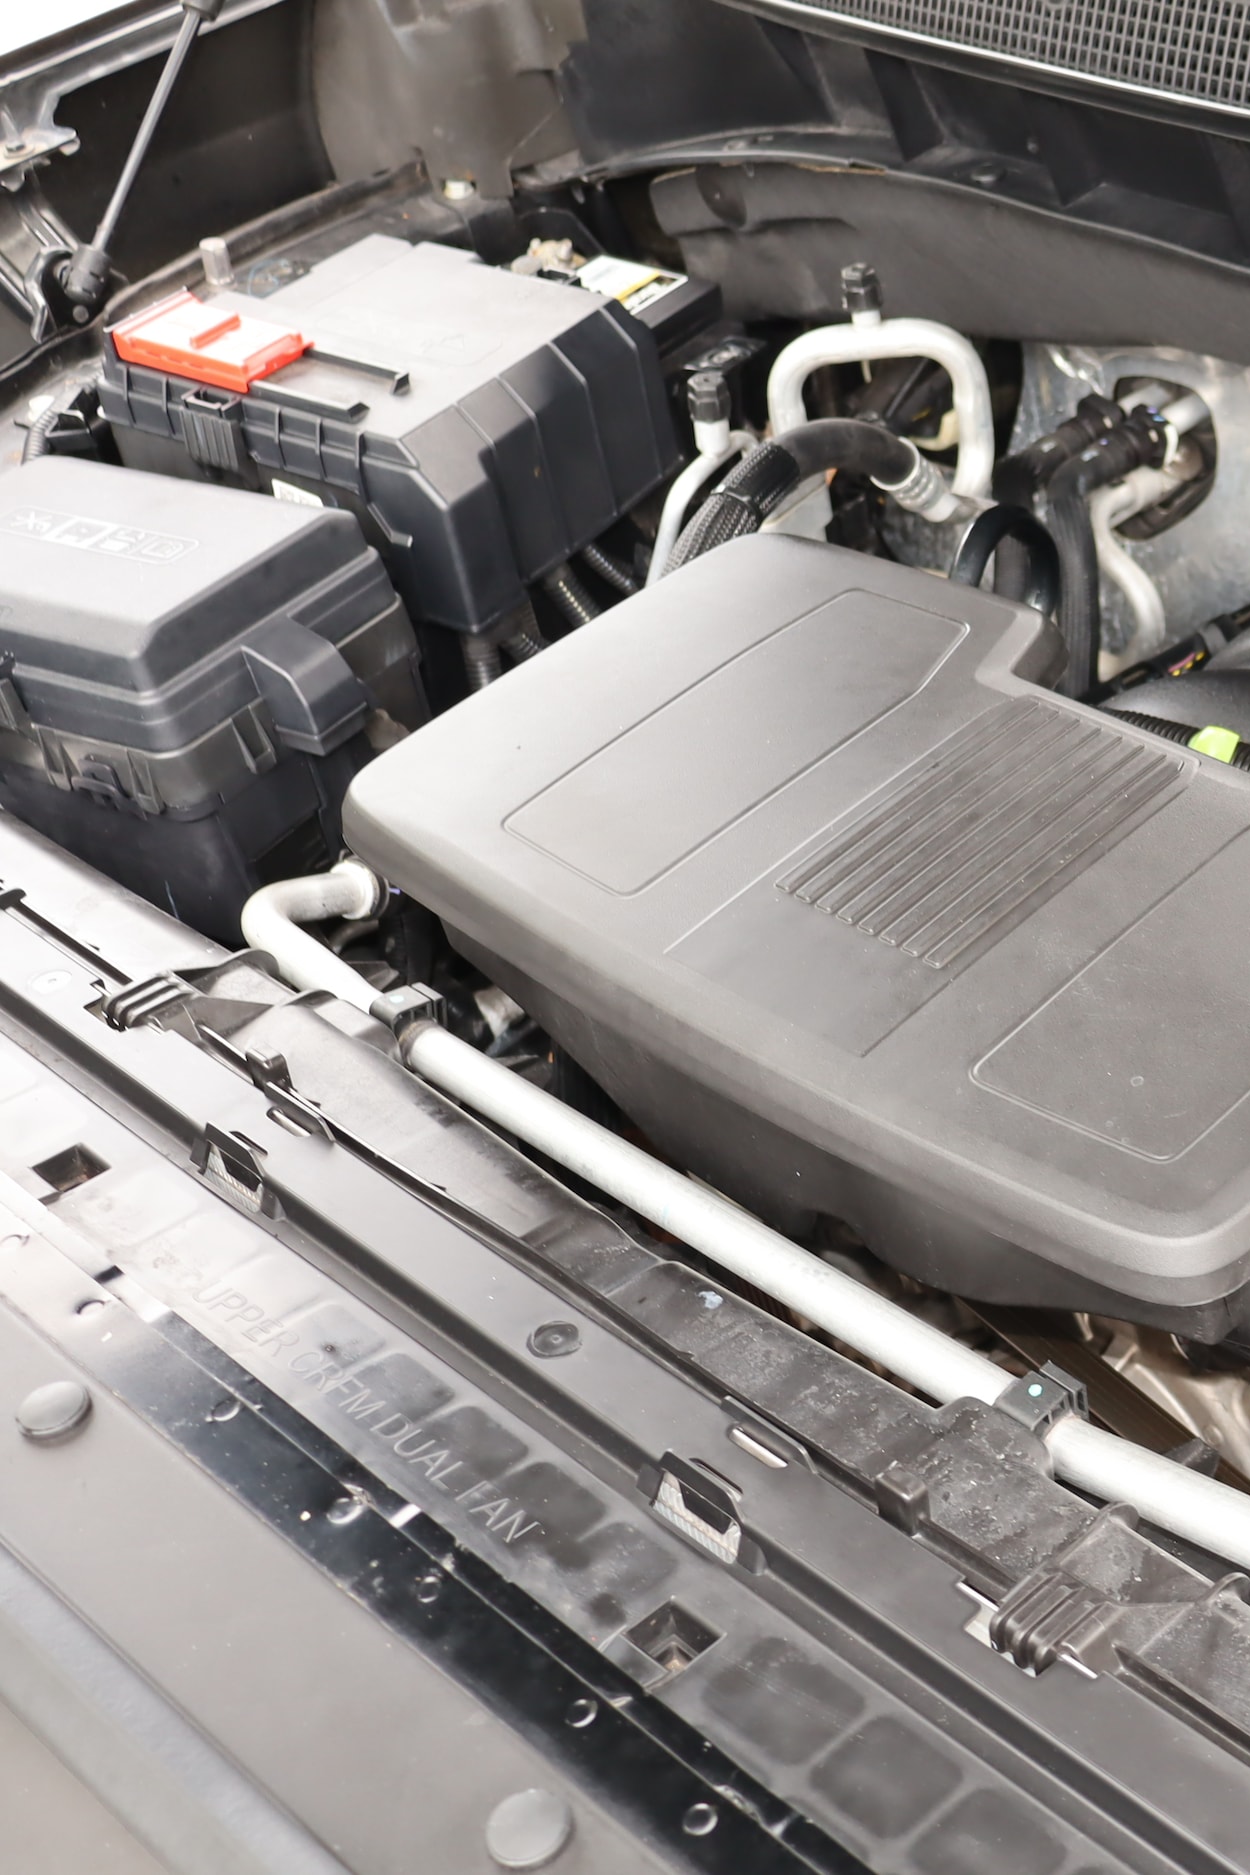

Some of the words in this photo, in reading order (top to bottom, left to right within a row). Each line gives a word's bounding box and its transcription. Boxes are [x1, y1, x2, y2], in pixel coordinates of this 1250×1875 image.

[192, 1280, 300, 1357] UPPER
[369, 1412, 463, 1489] DUAL
[455, 1480, 541, 1543] FAN
